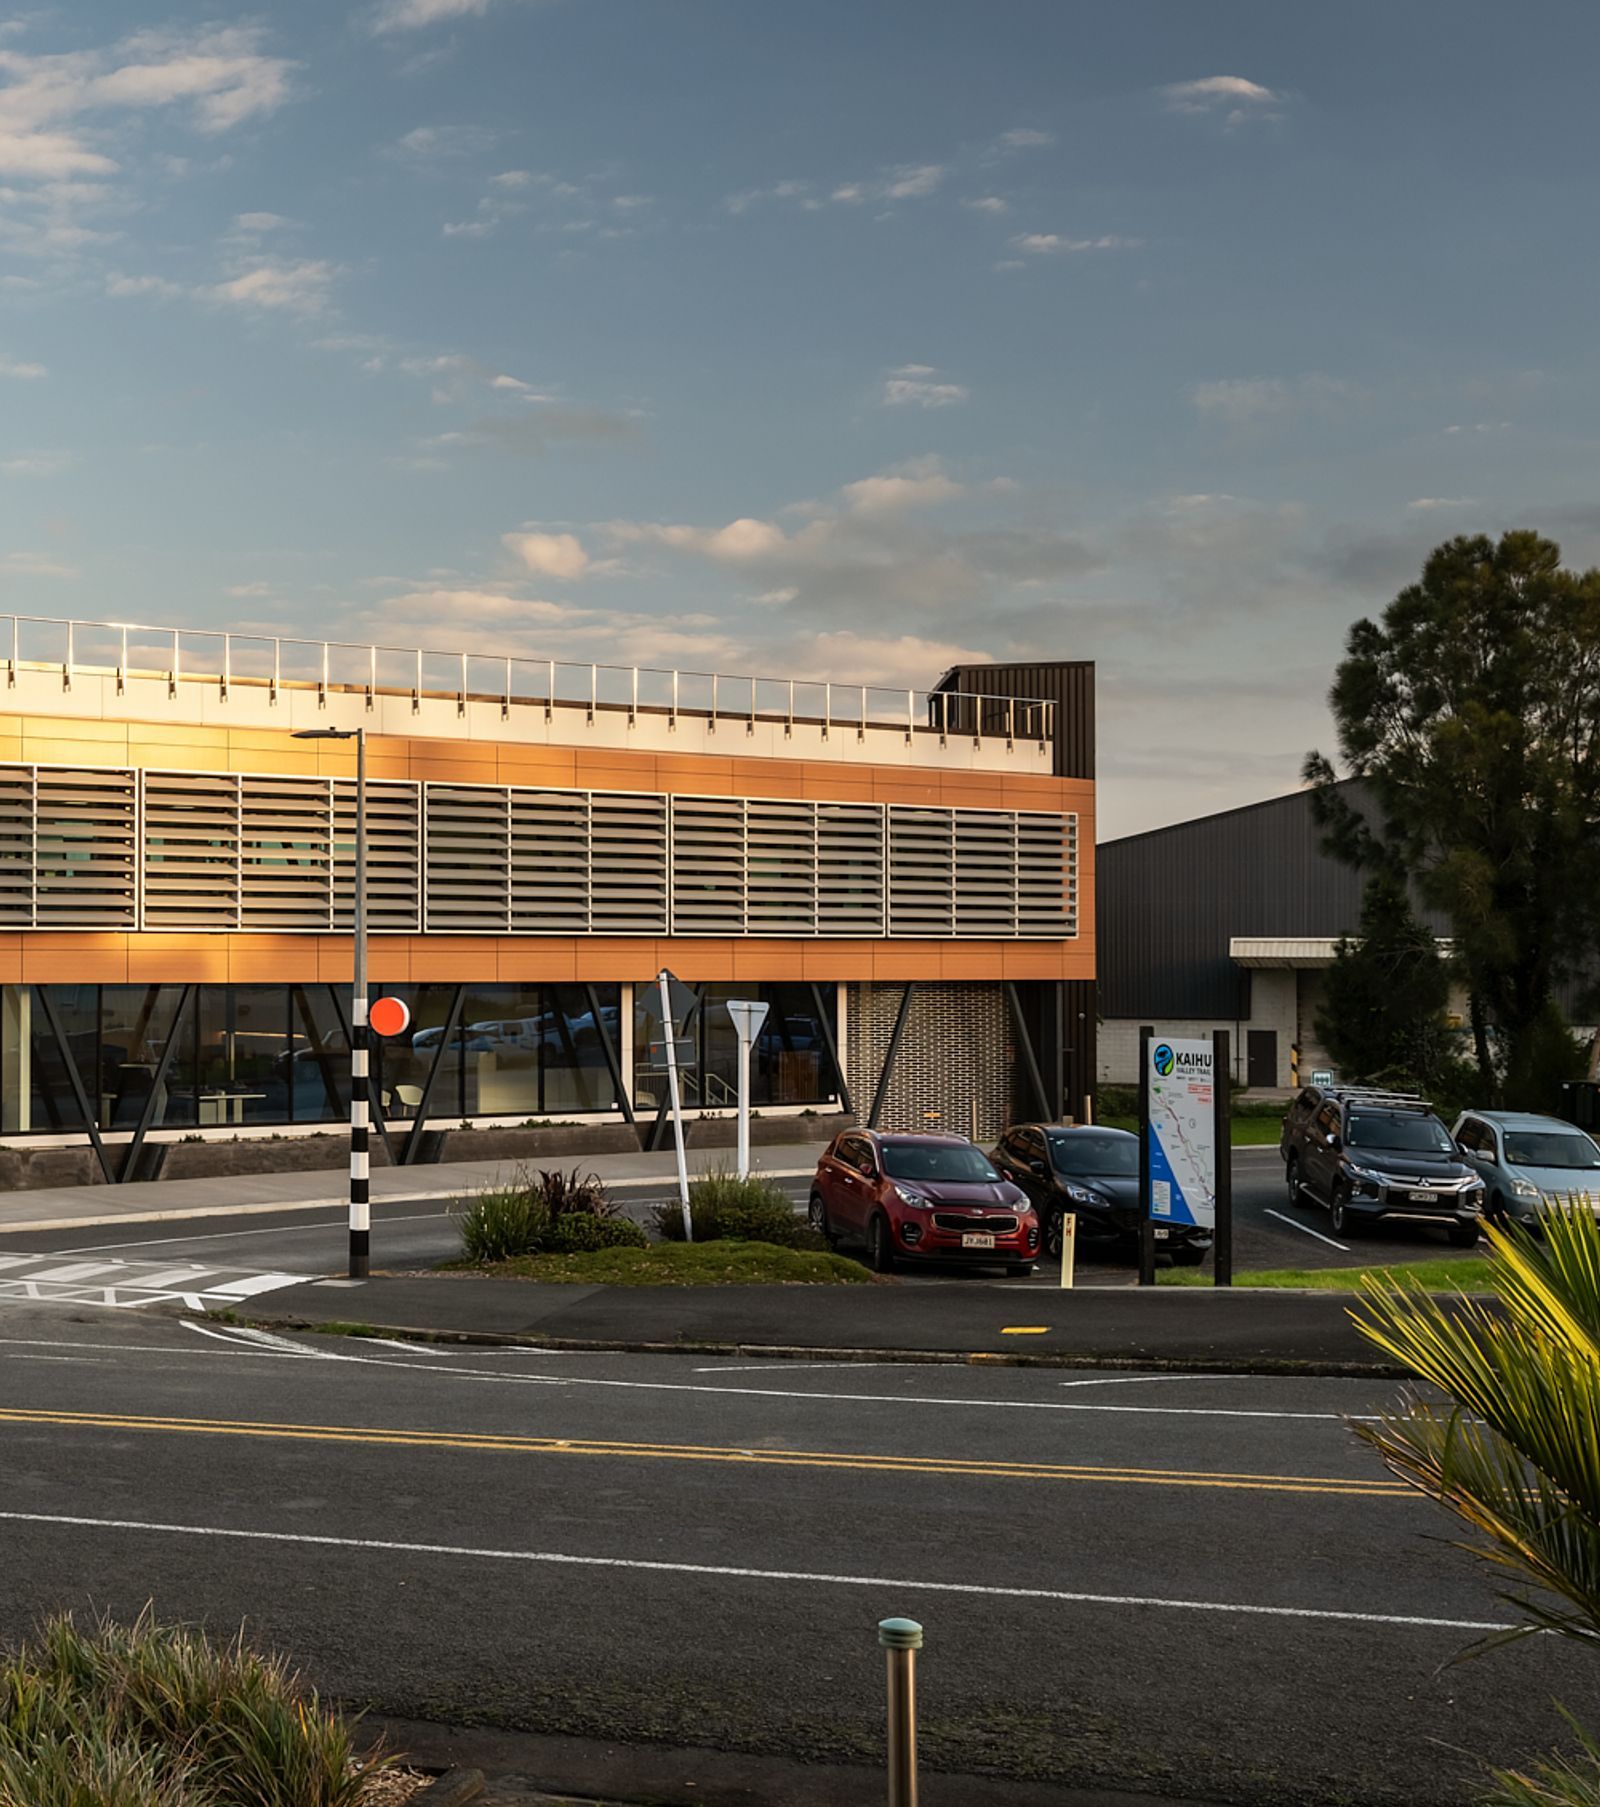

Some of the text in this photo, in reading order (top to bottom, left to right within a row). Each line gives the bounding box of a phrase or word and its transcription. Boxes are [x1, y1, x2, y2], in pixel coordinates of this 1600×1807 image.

[1176, 1052, 1213, 1067] KAIHU
[1176, 1067, 1212, 1076] VALLEY TRAIL
